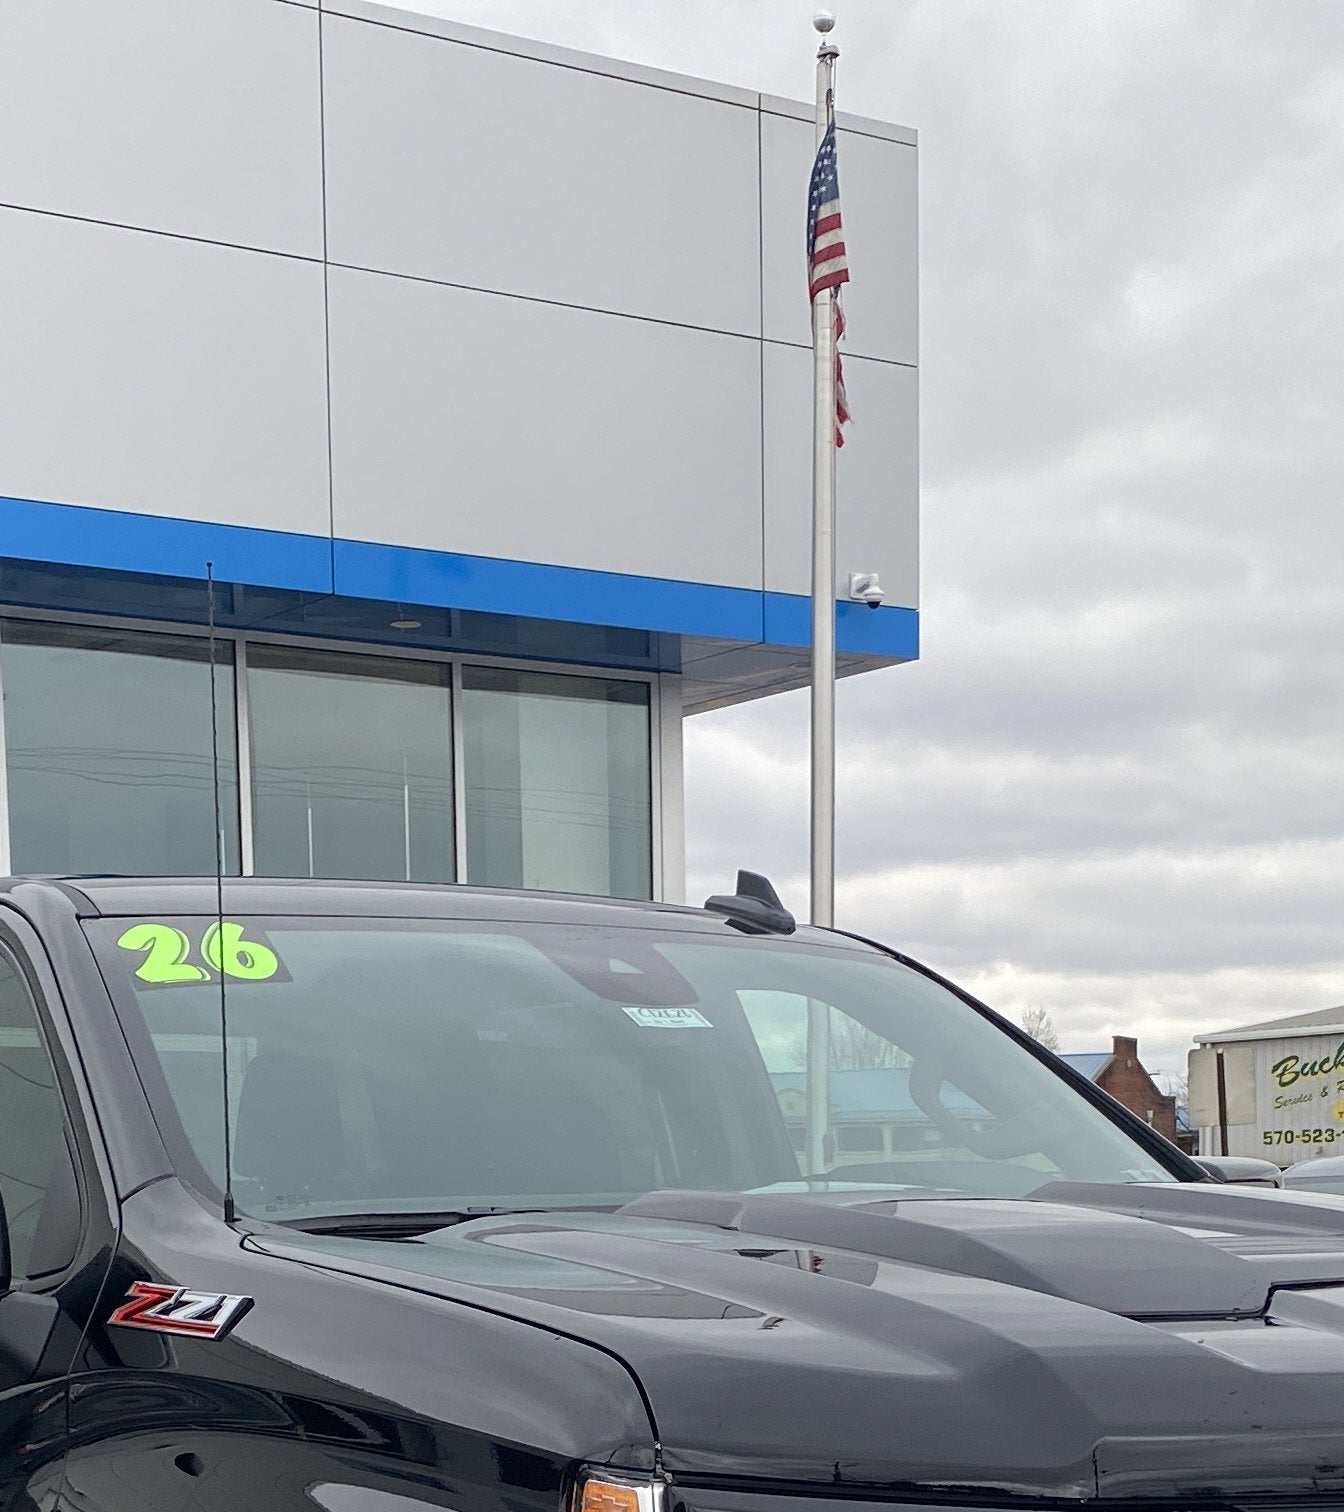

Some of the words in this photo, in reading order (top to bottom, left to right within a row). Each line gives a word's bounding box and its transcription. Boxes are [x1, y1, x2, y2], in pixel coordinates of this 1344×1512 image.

[117, 921, 278, 984] 26
[1274, 1093, 1313, 1109] Service
[106, 1280, 256, 1342] Z71
